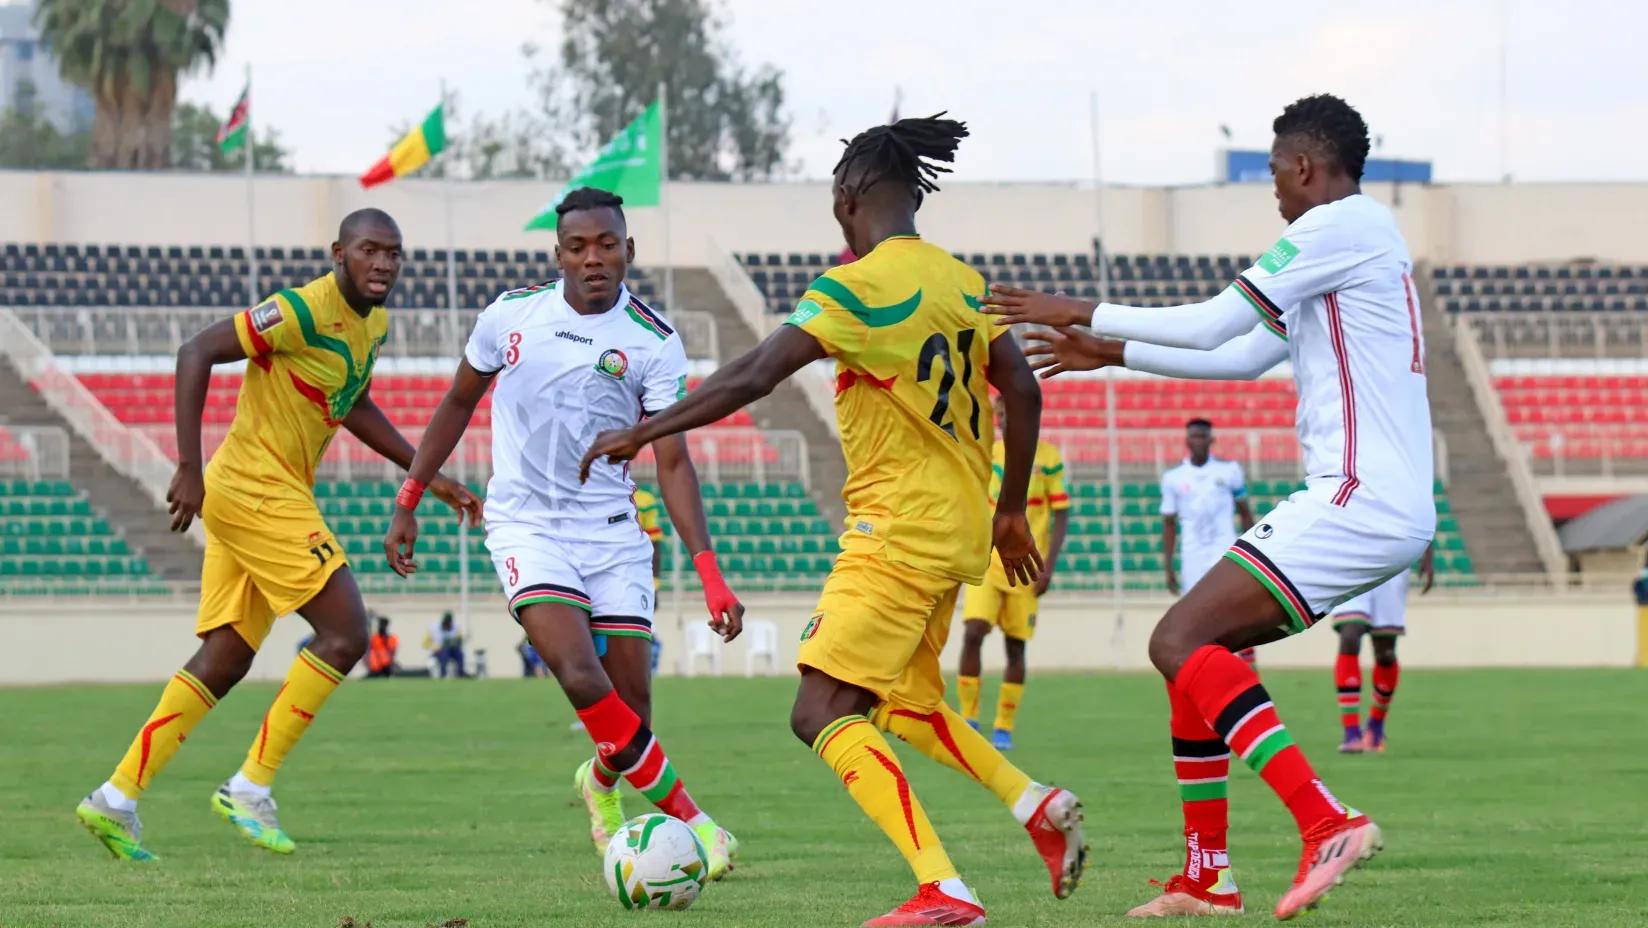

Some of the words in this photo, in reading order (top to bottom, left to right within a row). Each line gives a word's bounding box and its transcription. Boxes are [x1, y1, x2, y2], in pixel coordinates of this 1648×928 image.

[506, 331, 522, 366] 3
[555, 330, 593, 346] uhlsport
[917, 327, 980, 444] 21
[310, 542, 334, 565] 11
[506, 556, 519, 587] 3
